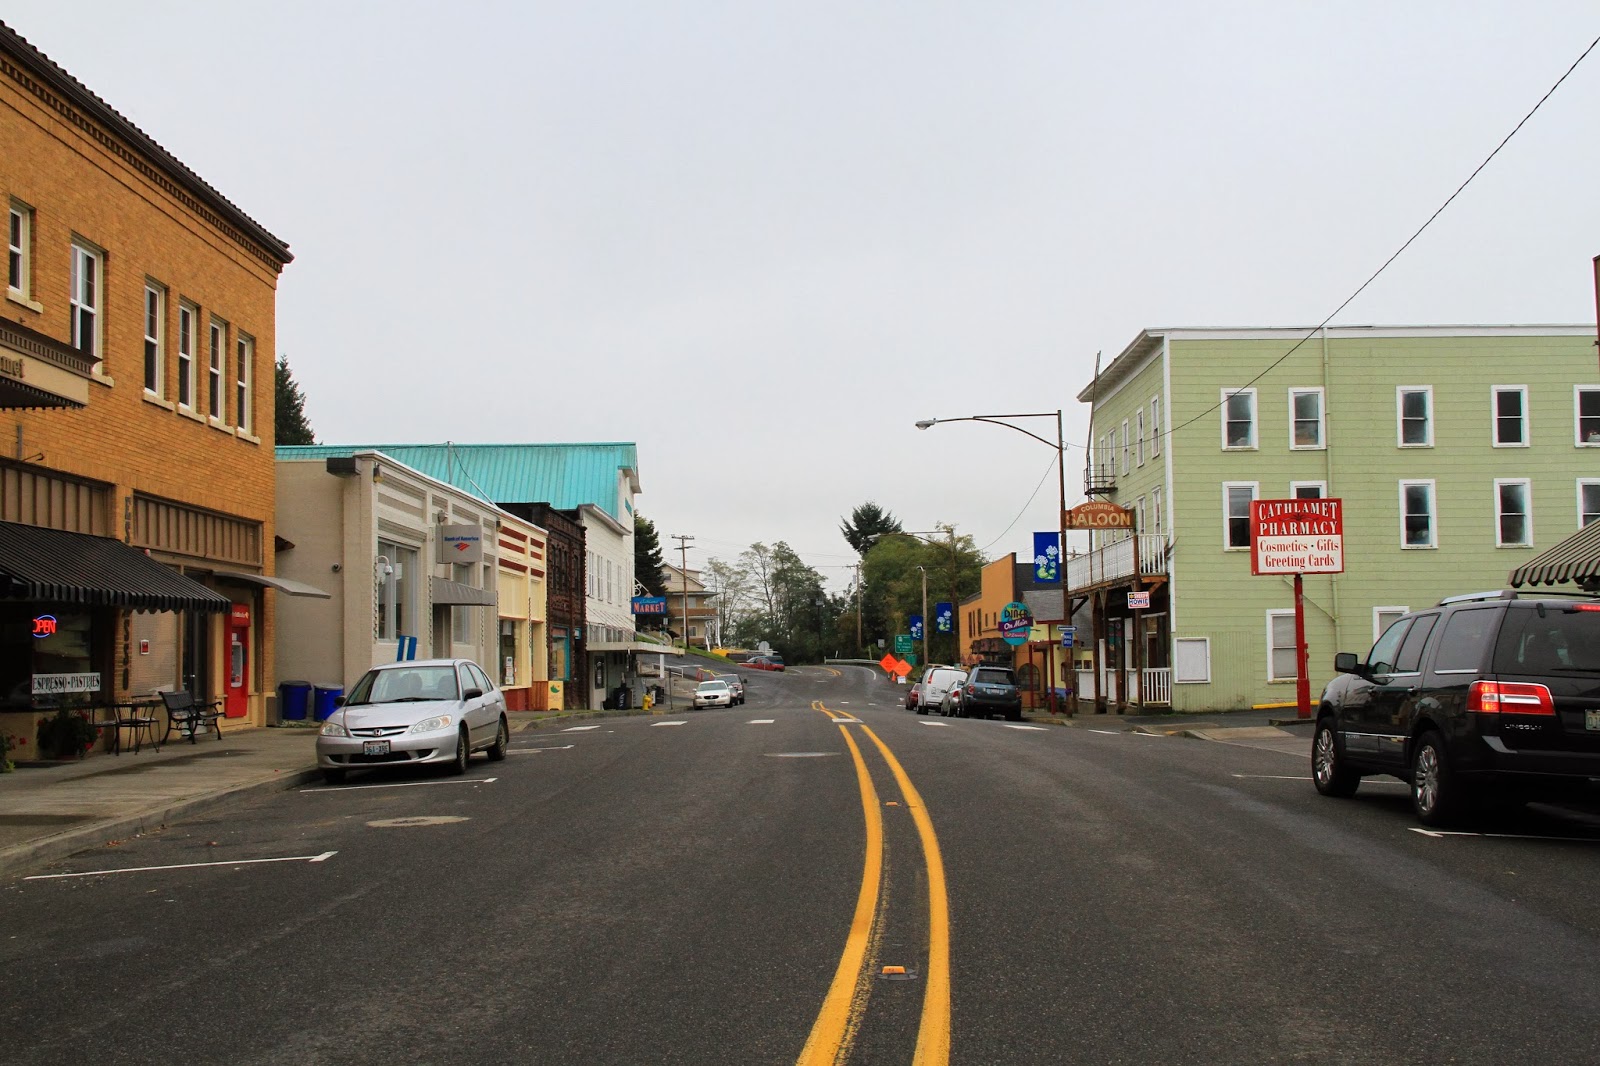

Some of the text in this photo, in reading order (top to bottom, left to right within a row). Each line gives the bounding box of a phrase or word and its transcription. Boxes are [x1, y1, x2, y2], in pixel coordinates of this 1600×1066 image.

[1080, 503, 1115, 513] COLUMBIA
[1258, 502, 1338, 521] CATHLAMET
[1066, 512, 1131, 526] SALOON
[1259, 521, 1338, 536] PHARMACY
[1260, 538, 1339, 553] Cosmetics Gifts
[1265, 553, 1335, 570] Greeting Cards
[633, 602, 665, 613] MARKET
[1004, 609, 1029, 619] DINER
[1003, 619, 1028, 630] On Main
[32, 675, 100, 691] ESPRESSO PASTRIES
